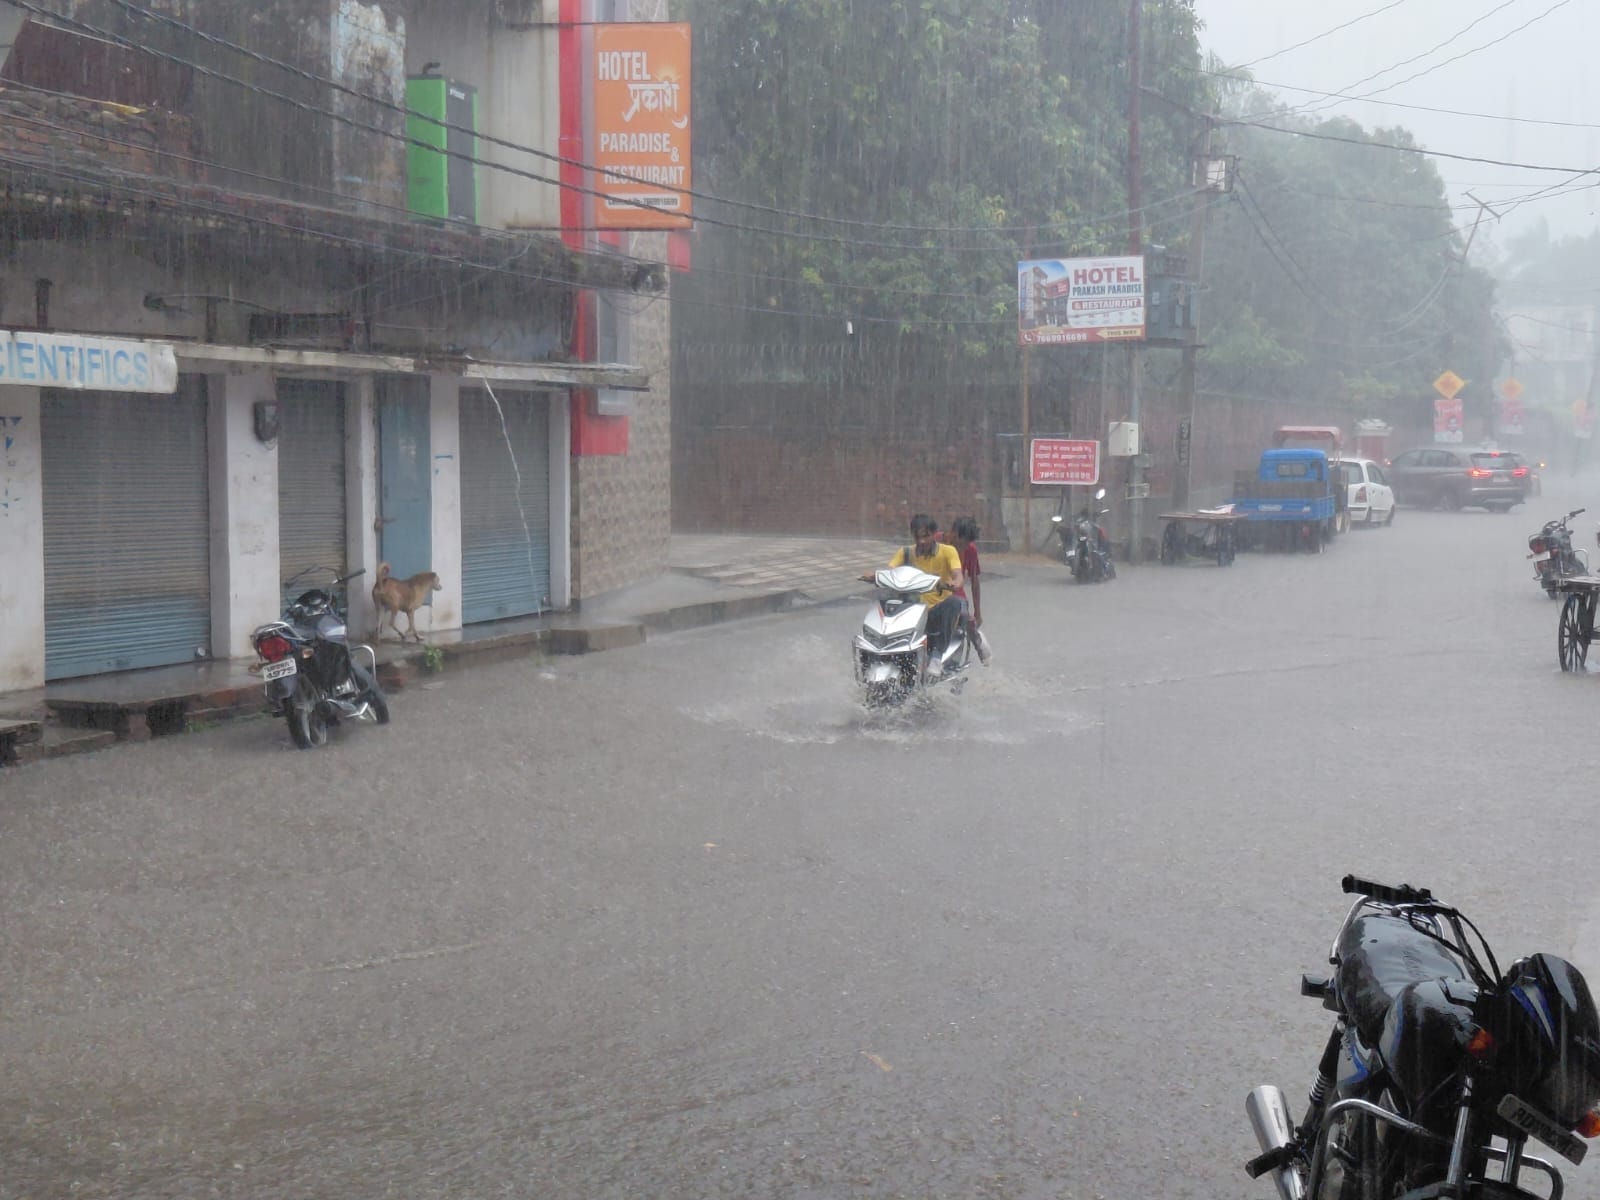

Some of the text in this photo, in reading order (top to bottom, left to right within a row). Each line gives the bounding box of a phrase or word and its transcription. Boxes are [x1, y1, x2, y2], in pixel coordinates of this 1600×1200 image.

[598, 51, 651, 80] HOTEL
[600, 133, 680, 163] PARADISE &
[604, 165, 685, 185] RESTAURANT
[1074, 266, 1140, 285] HOTEL
[1072, 285, 1106, 296] PRAKASH
[1107, 283, 1142, 295] PARADISE
[1082, 299, 1138, 310] RESTAURANT
[0, 341, 148, 388] IENTIFICS
